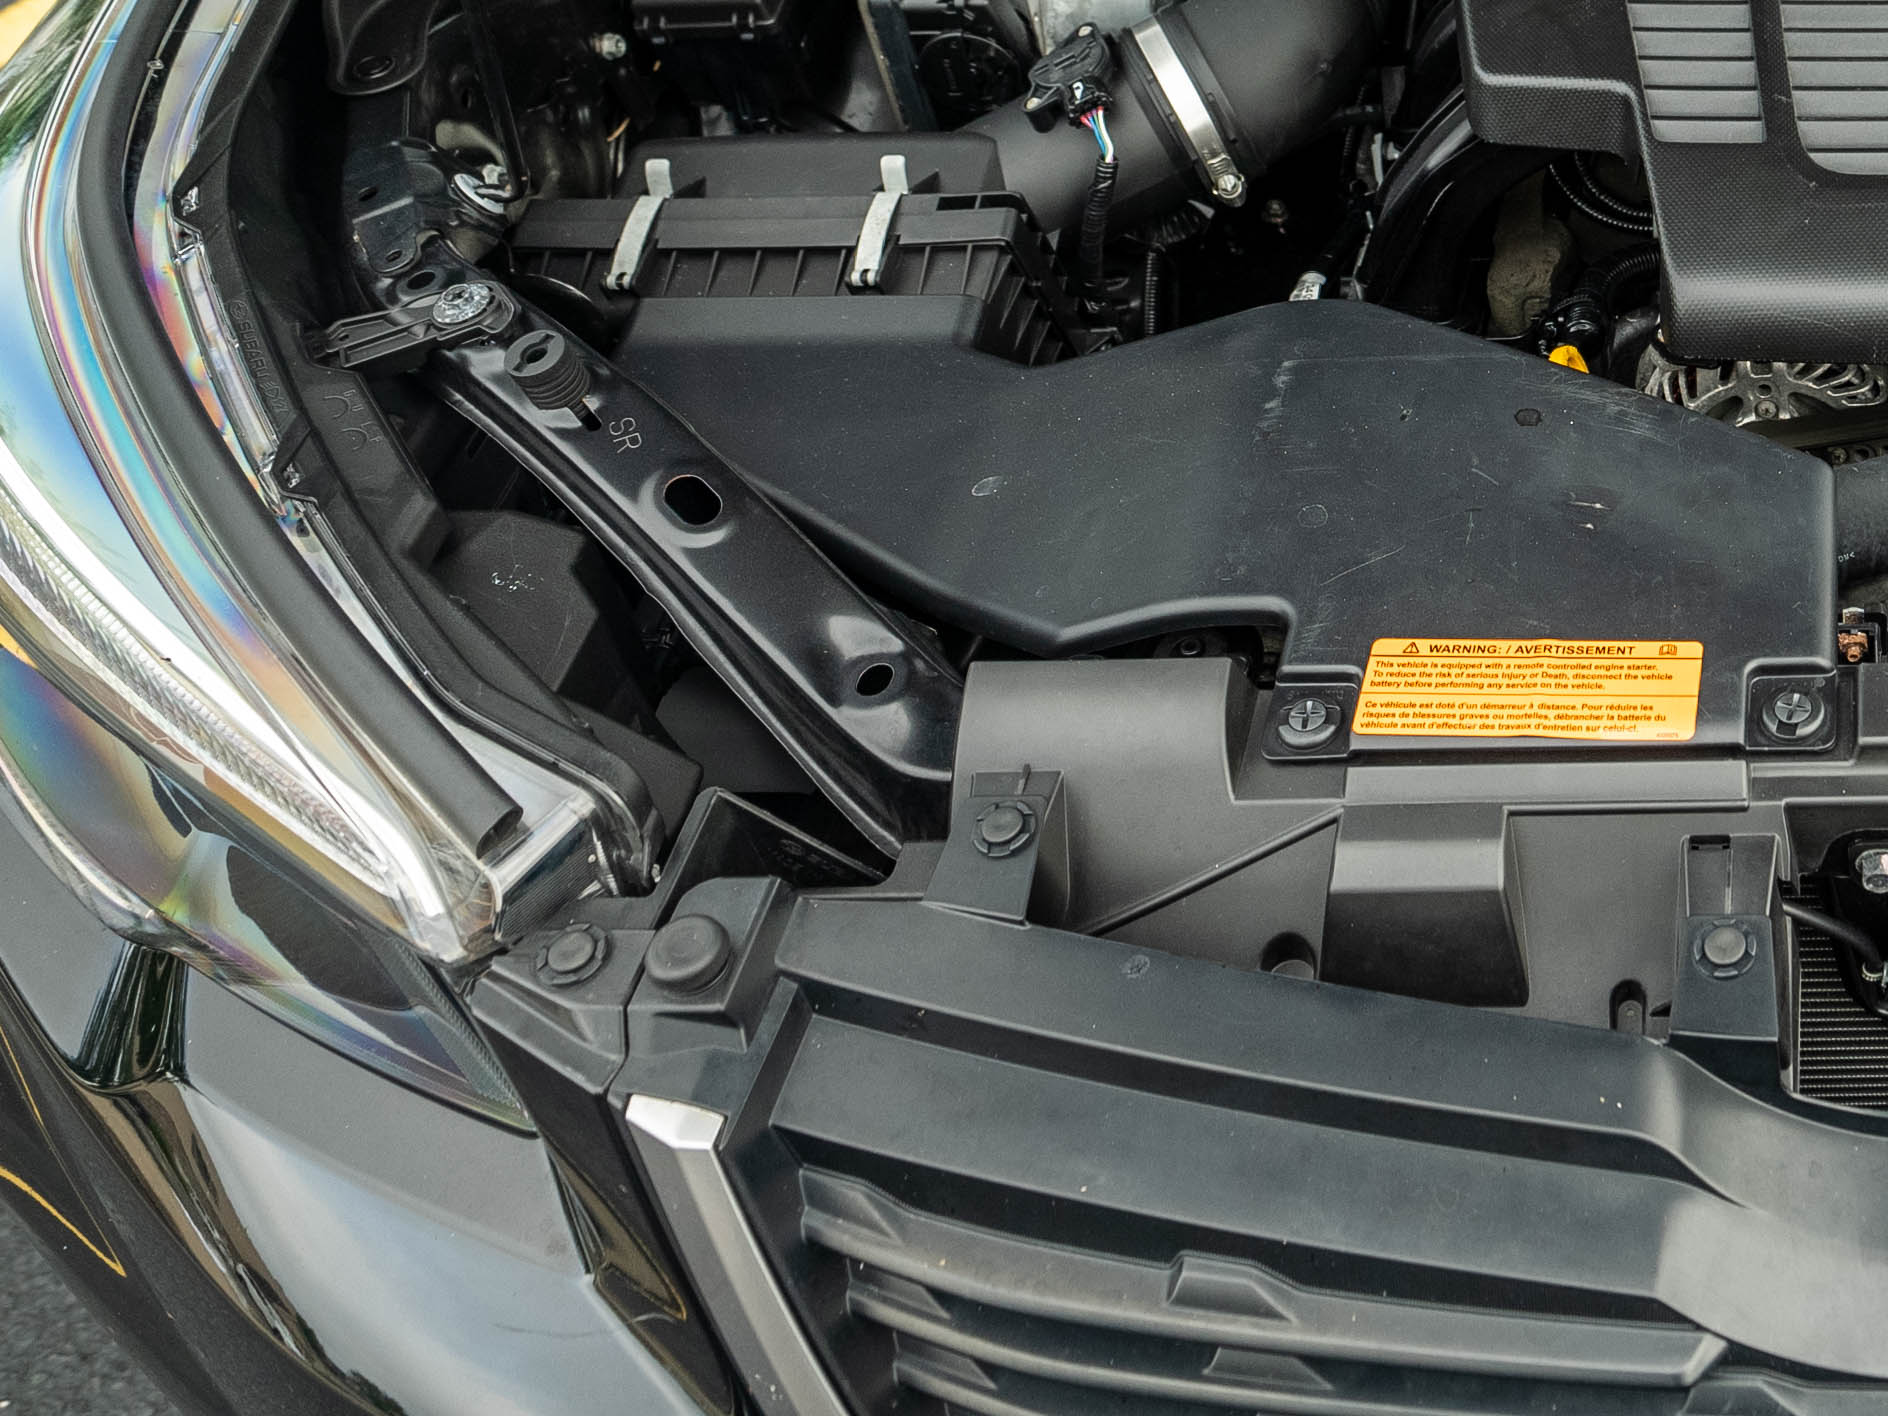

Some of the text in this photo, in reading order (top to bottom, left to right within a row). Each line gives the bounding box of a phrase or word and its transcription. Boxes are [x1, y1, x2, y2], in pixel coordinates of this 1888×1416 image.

[608, 417, 643, 454] SR
[1429, 644, 1502, 654] WARNING:
[1514, 644, 1636, 655] AVERTISSEMENT
[1375, 660, 1395, 668] This
[1397, 661, 1428, 669] vehicle
[1441, 661, 1483, 671] equipped
[1485, 661, 1503, 669] with
[1546, 662, 1592, 670] controlled
[1594, 663, 1624, 672] engine
[1627, 663, 1658, 671] starter.
[1386, 670, 1417, 678] reduce
[1419, 670, 1433, 678] the
[1435, 670, 1451, 678] risk
[1466, 671, 1499, 679] serious
[1541, 671, 1569, 681] Death,
[1572, 672, 1622, 680] disconnect
[1640, 673, 1673, 681] vehicle
[1370, 680, 1401, 689] battery
[1404, 680, 1432, 688] before
[1434, 681, 1484, 690] performing
[1486, 682, 1503, 690] any
[1505, 681, 1538, 689] service
[1554, 681, 1569, 689] the
[1571, 682, 1605, 690] vehicle.
[1379, 700, 1417, 709] véhicule
[1435, 700, 1456, 709] doté
[1458, 701, 1478, 709] d'un
[1479, 701, 1527, 710] démarreur
[1537, 702, 1577, 711] distance.
[1581, 703, 1603, 711] Pour
[1605, 703, 1638, 711] réduire
[1362, 711, 1396, 720] risques
[1412, 711, 1457, 719] blessures
[1459, 713, 1490, 721] graves
[1506, 713, 1550, 721] mortelles,
[1553, 712, 1604, 721] débrancher
[1617, 713, 1652, 721] batterie
[1360, 721, 1398, 729] véhicule
[1427, 721, 1476, 730] d'effectuer
[1478, 722, 1496, 730] des
[1497, 722, 1531, 731] travaux
[1534, 723, 1583, 732] d'entretien
